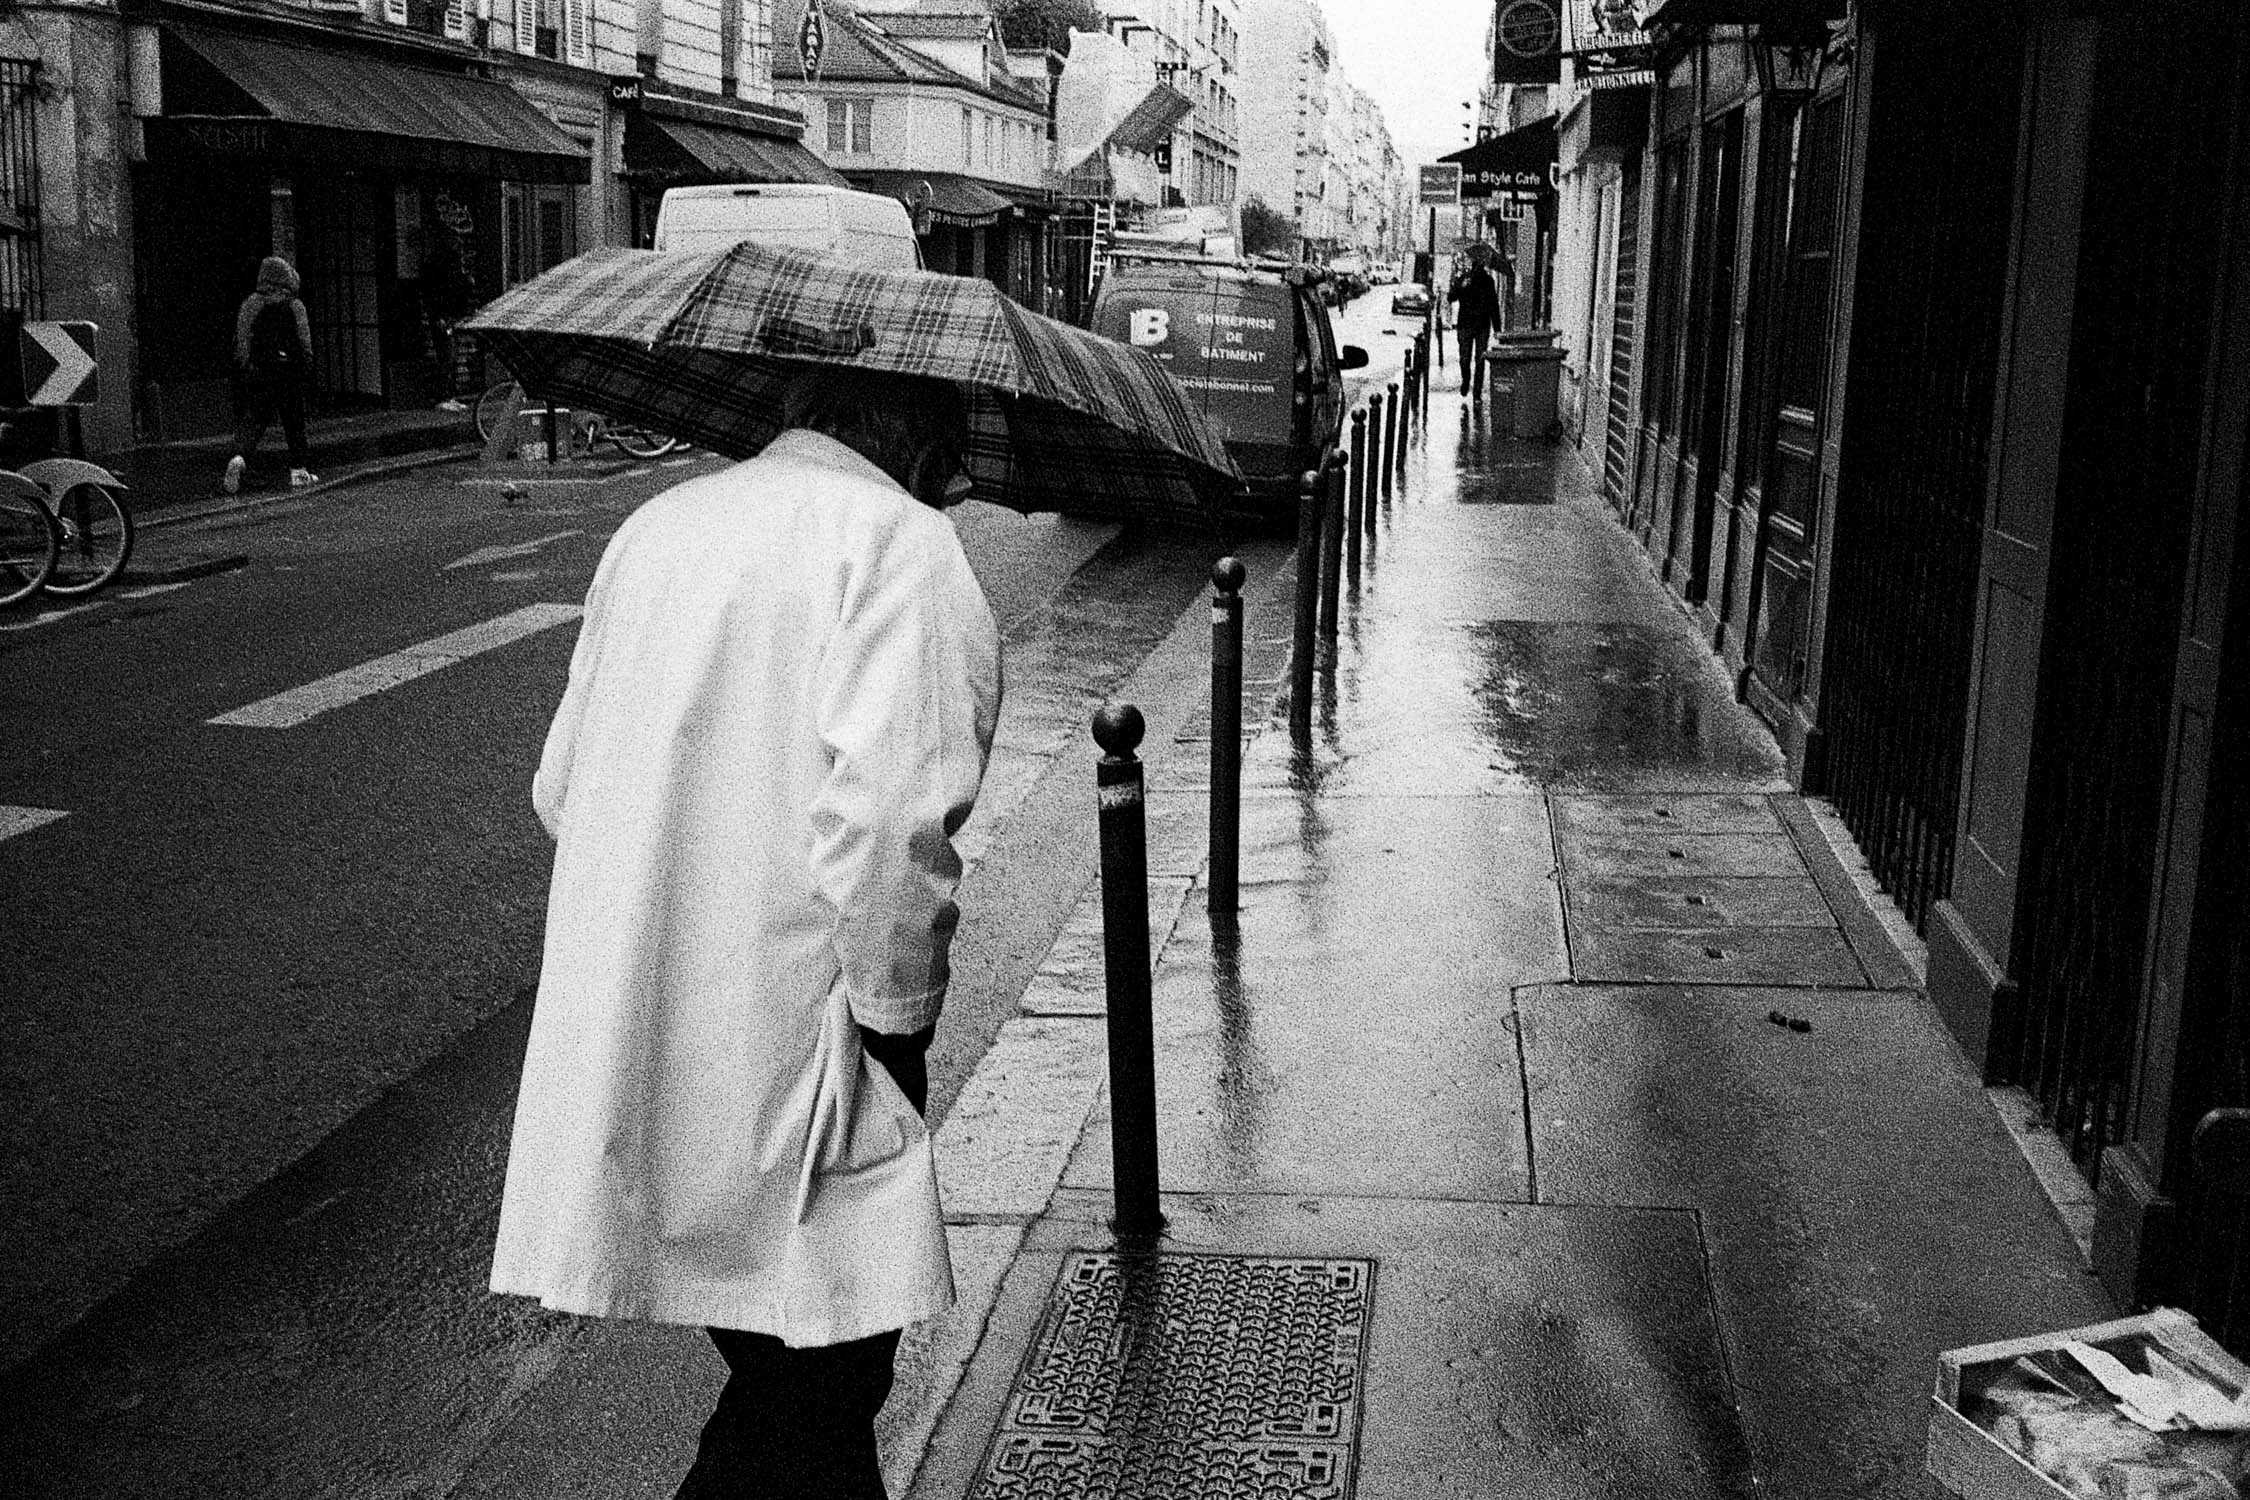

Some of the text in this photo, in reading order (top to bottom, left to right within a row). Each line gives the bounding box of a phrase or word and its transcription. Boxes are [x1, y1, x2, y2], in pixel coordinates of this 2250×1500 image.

[806, 11, 818, 70] TABAC
[1480, 170, 1512, 186] Style
[1196, 313, 1277, 331] ENTREPRISE
[1225, 331, 1244, 344] DE
[1201, 346, 1266, 363] BATIMENT
